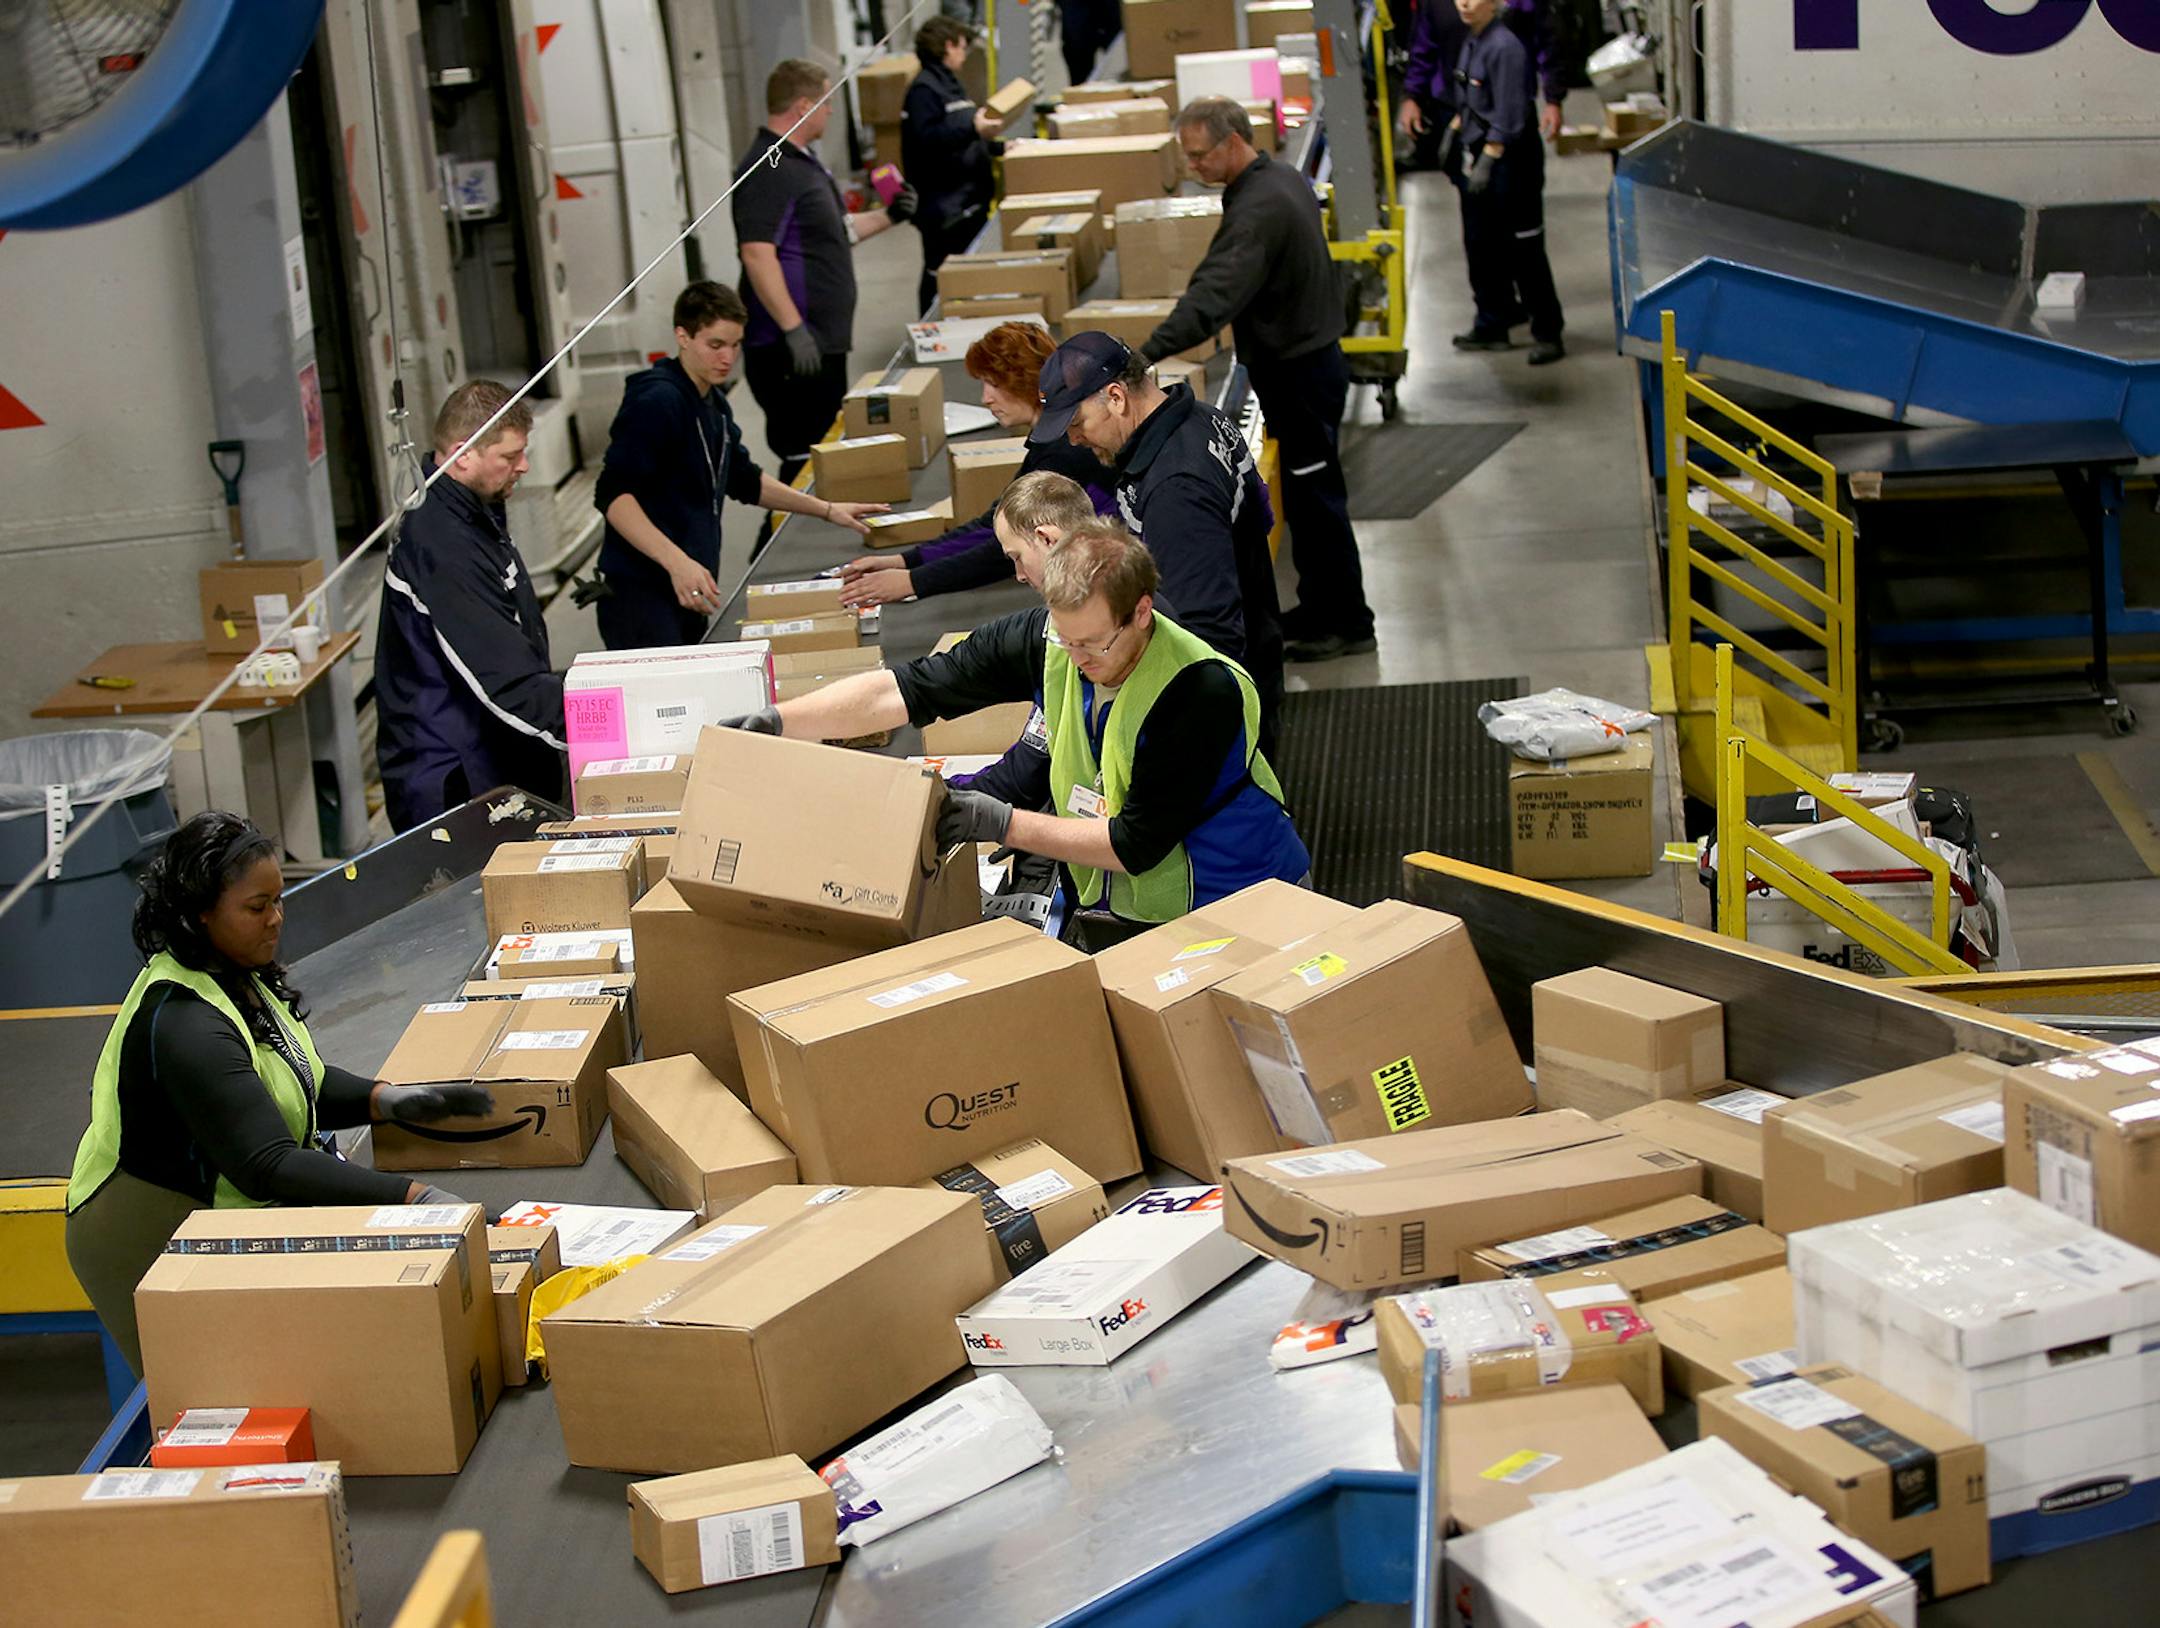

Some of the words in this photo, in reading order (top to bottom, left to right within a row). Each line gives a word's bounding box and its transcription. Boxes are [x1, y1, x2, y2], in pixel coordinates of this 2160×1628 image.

[568, 699, 583, 711] FY
[586, 699, 598, 711] 15
[599, 698, 614, 711] EC
[576, 711, 607, 724] HRBB
[854, 886, 871, 902] Gift
[871, 889, 899, 905] Cards
[537, 922, 571, 933] Wolters
[572, 921, 601, 931] Kluwer
[1379, 1060, 1425, 1125] FRAGILE
[925, 1082, 1020, 1130] QUEST
[962, 1100, 1018, 1122] NUTRITION
[1009, 1239, 1033, 1259] fire
[1099, 1297, 1148, 1336] FedEx
[964, 1333, 1004, 1350] FedEx
[1039, 1337, 1070, 1353] Large
[1073, 1337, 1095, 1351] Box
